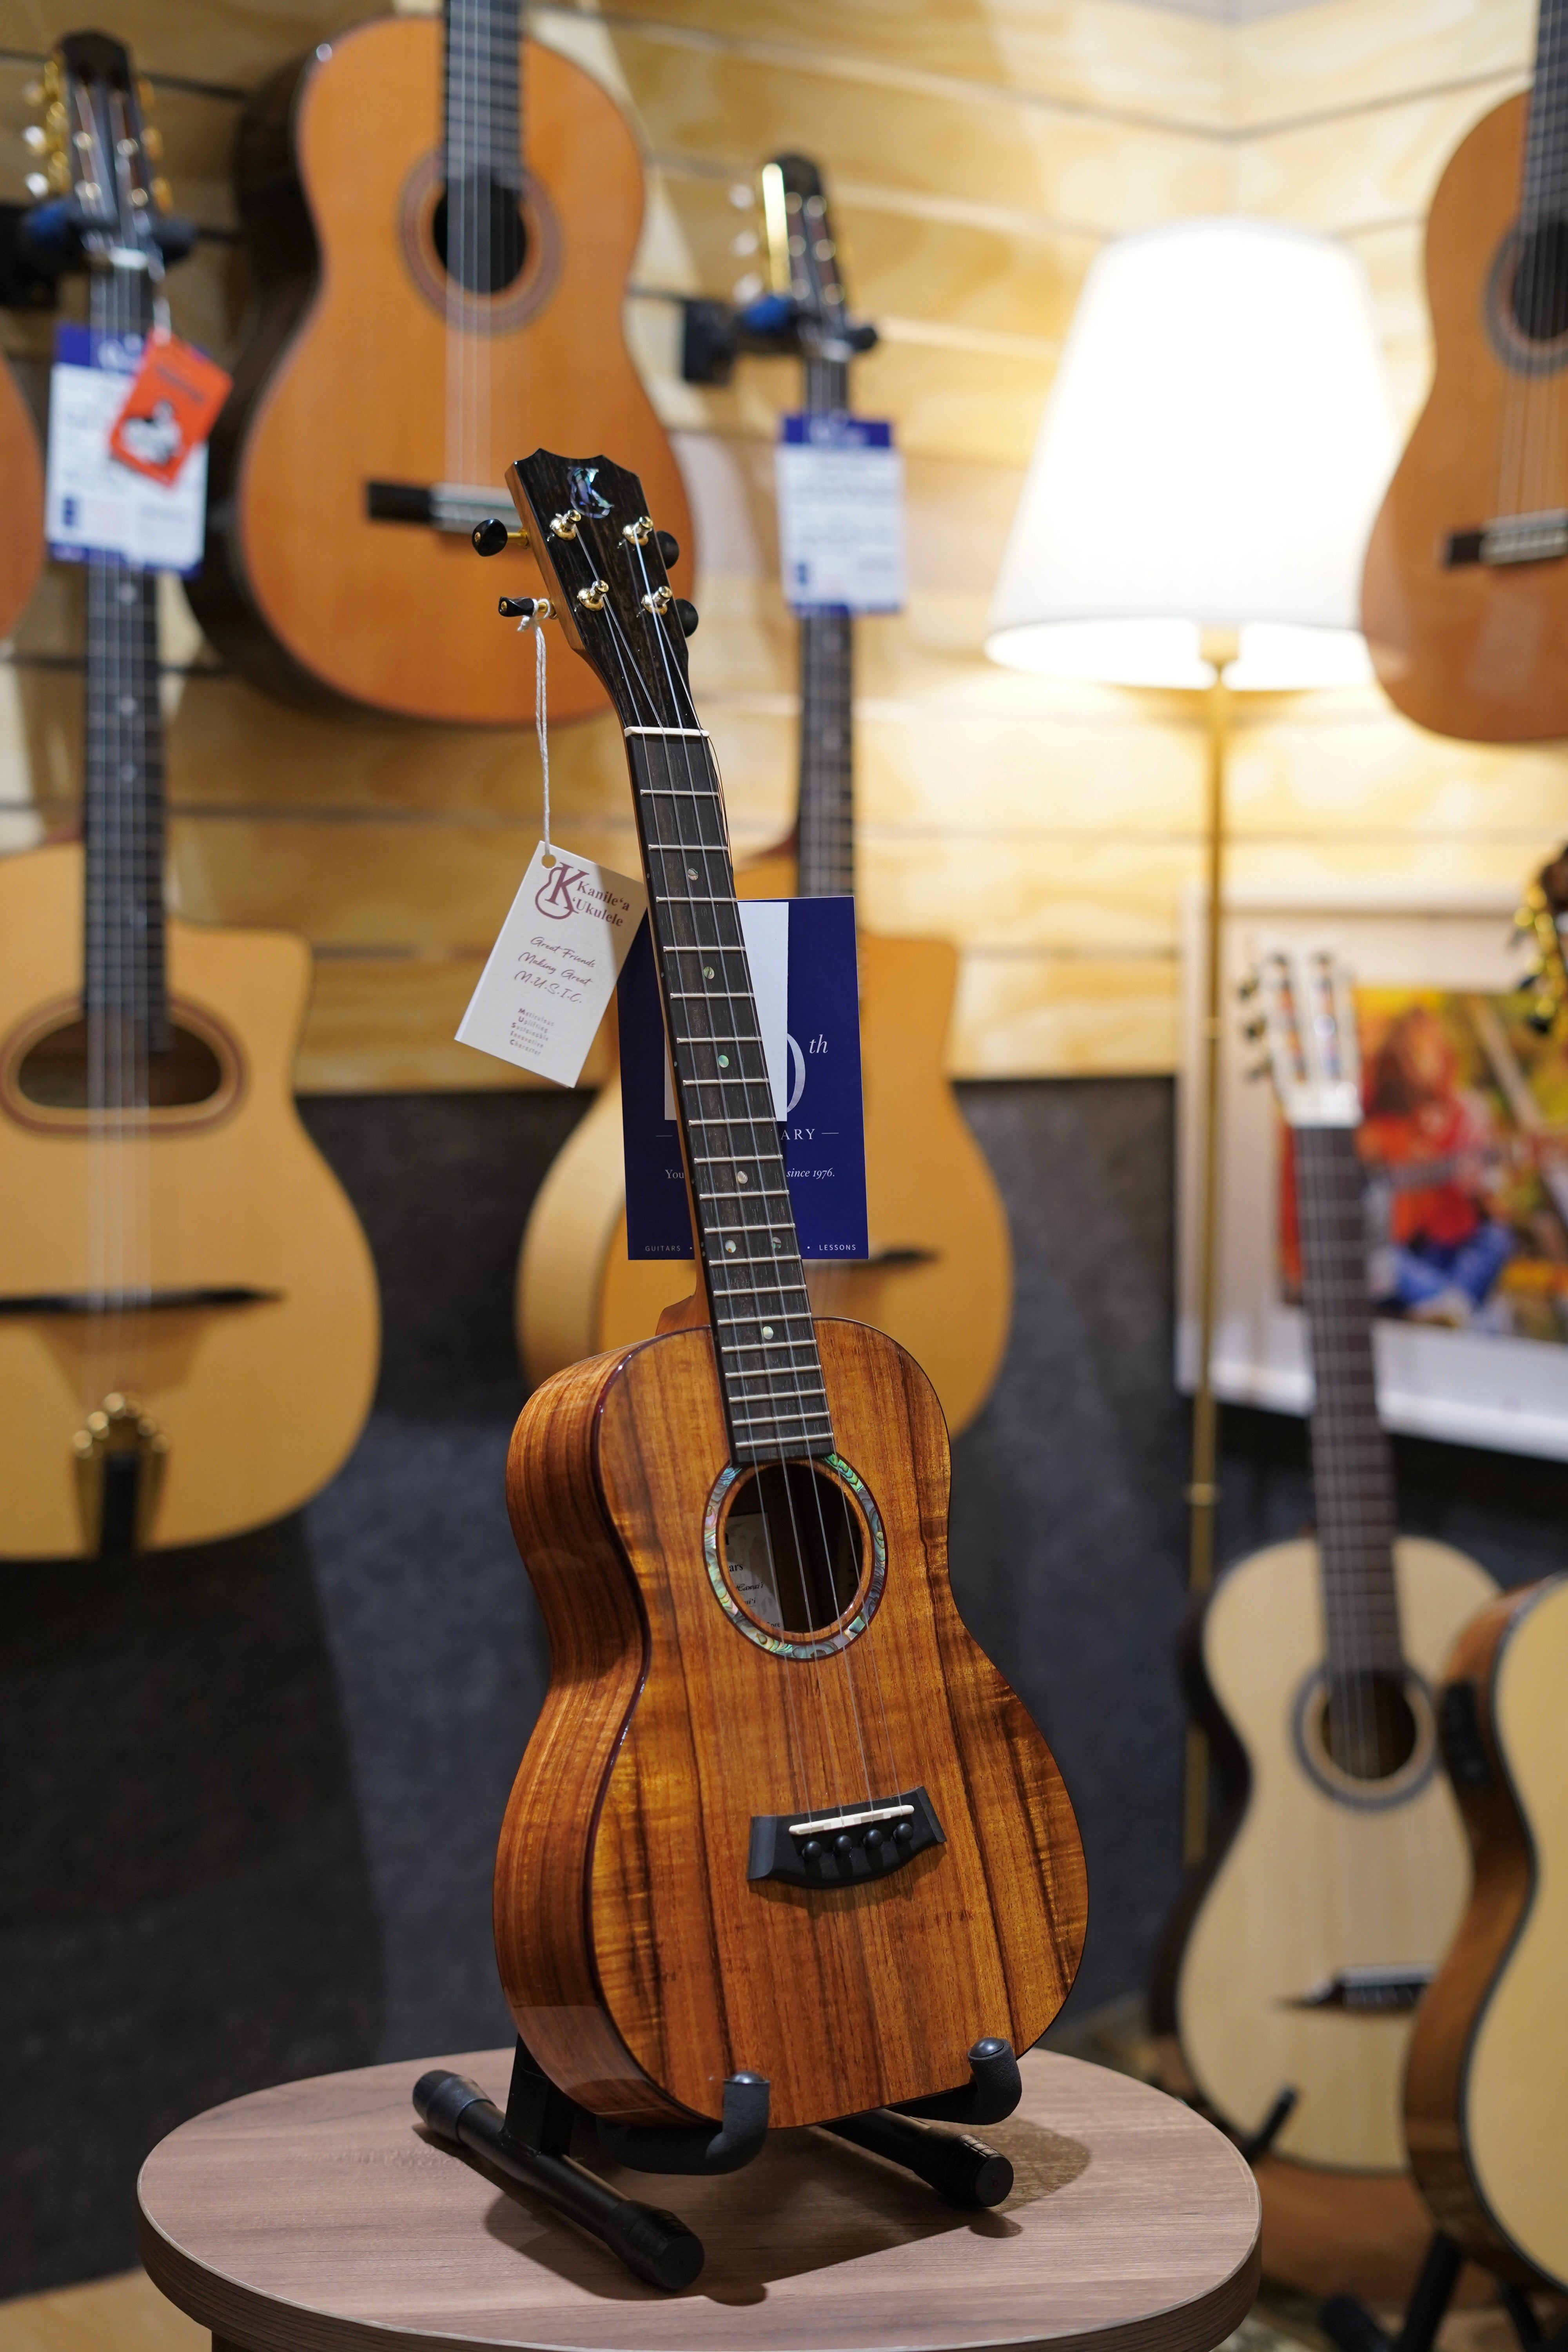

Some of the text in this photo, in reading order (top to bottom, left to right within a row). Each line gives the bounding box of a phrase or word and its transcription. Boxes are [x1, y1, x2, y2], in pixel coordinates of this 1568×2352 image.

[576, 880, 630, 911] Kanile‘a
[572, 897, 623, 927] ‘Ukulele
[530, 936, 596, 968] Great Friends
[518, 952, 594, 986] Making Great
[514, 971, 582, 1003] M.U.S.I.C.
[786, 1167, 835, 1180] since 1976.
